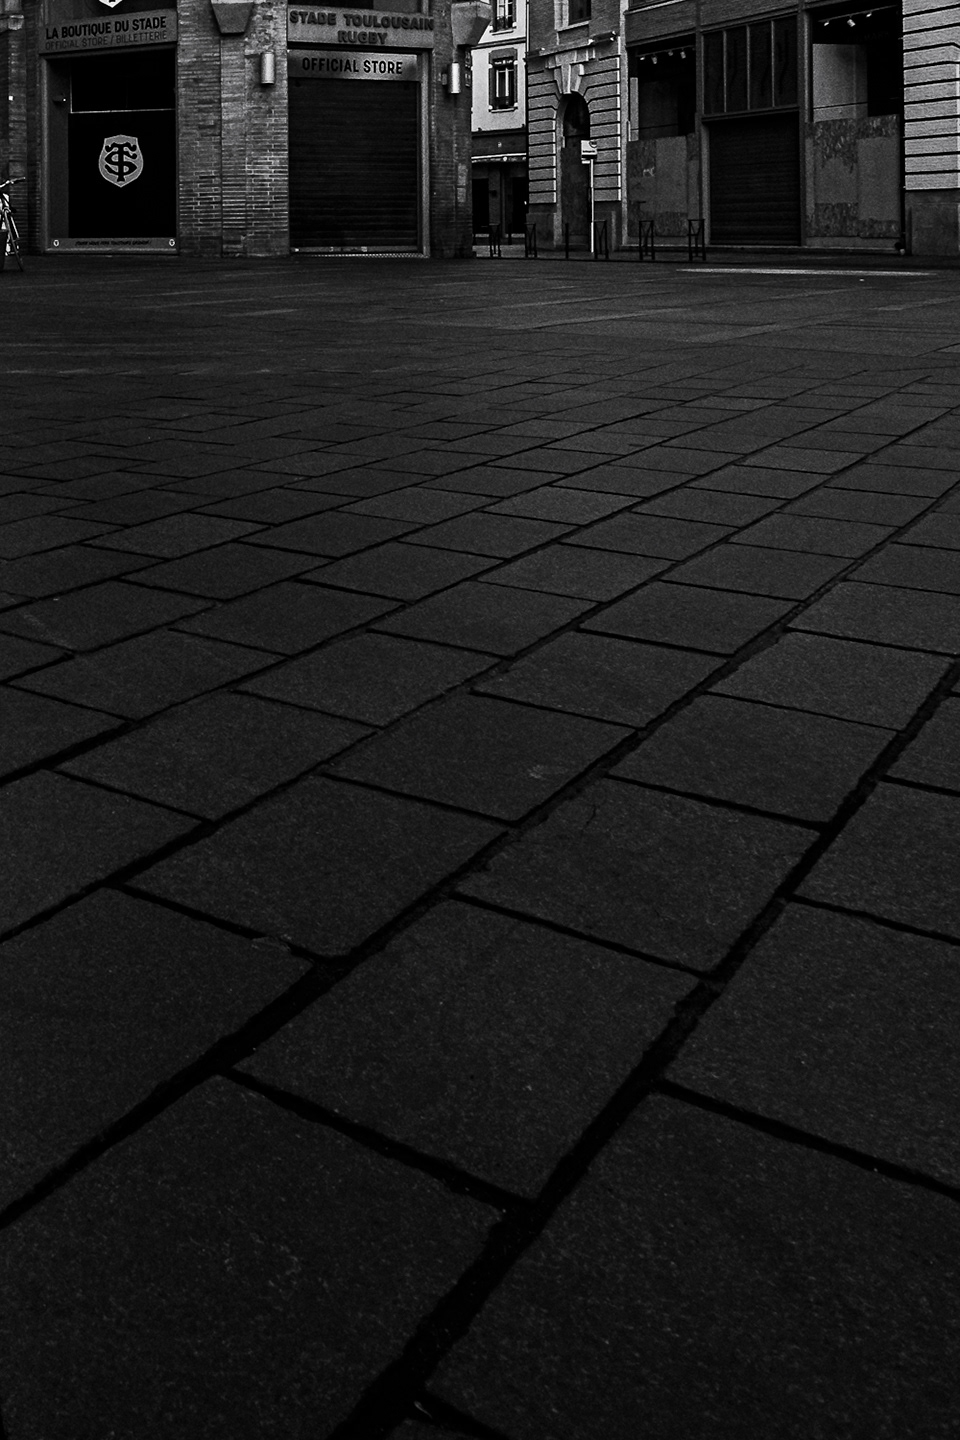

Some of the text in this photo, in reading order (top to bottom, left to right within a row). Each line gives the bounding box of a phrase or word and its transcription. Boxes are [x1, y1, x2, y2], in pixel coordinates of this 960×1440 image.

[46, 16, 167, 40] LA BOUTIQUE DU STADE
[289, 10, 435, 31] STADE TOULOUSAIN
[45, 39, 79, 51] OFFICIAL
[82, 36, 108, 48] STORE
[116, 30, 168, 44] BILLETTERIE
[337, 30, 388, 45] RUGBY
[302, 57, 403, 75] OFFICIAL STORE
